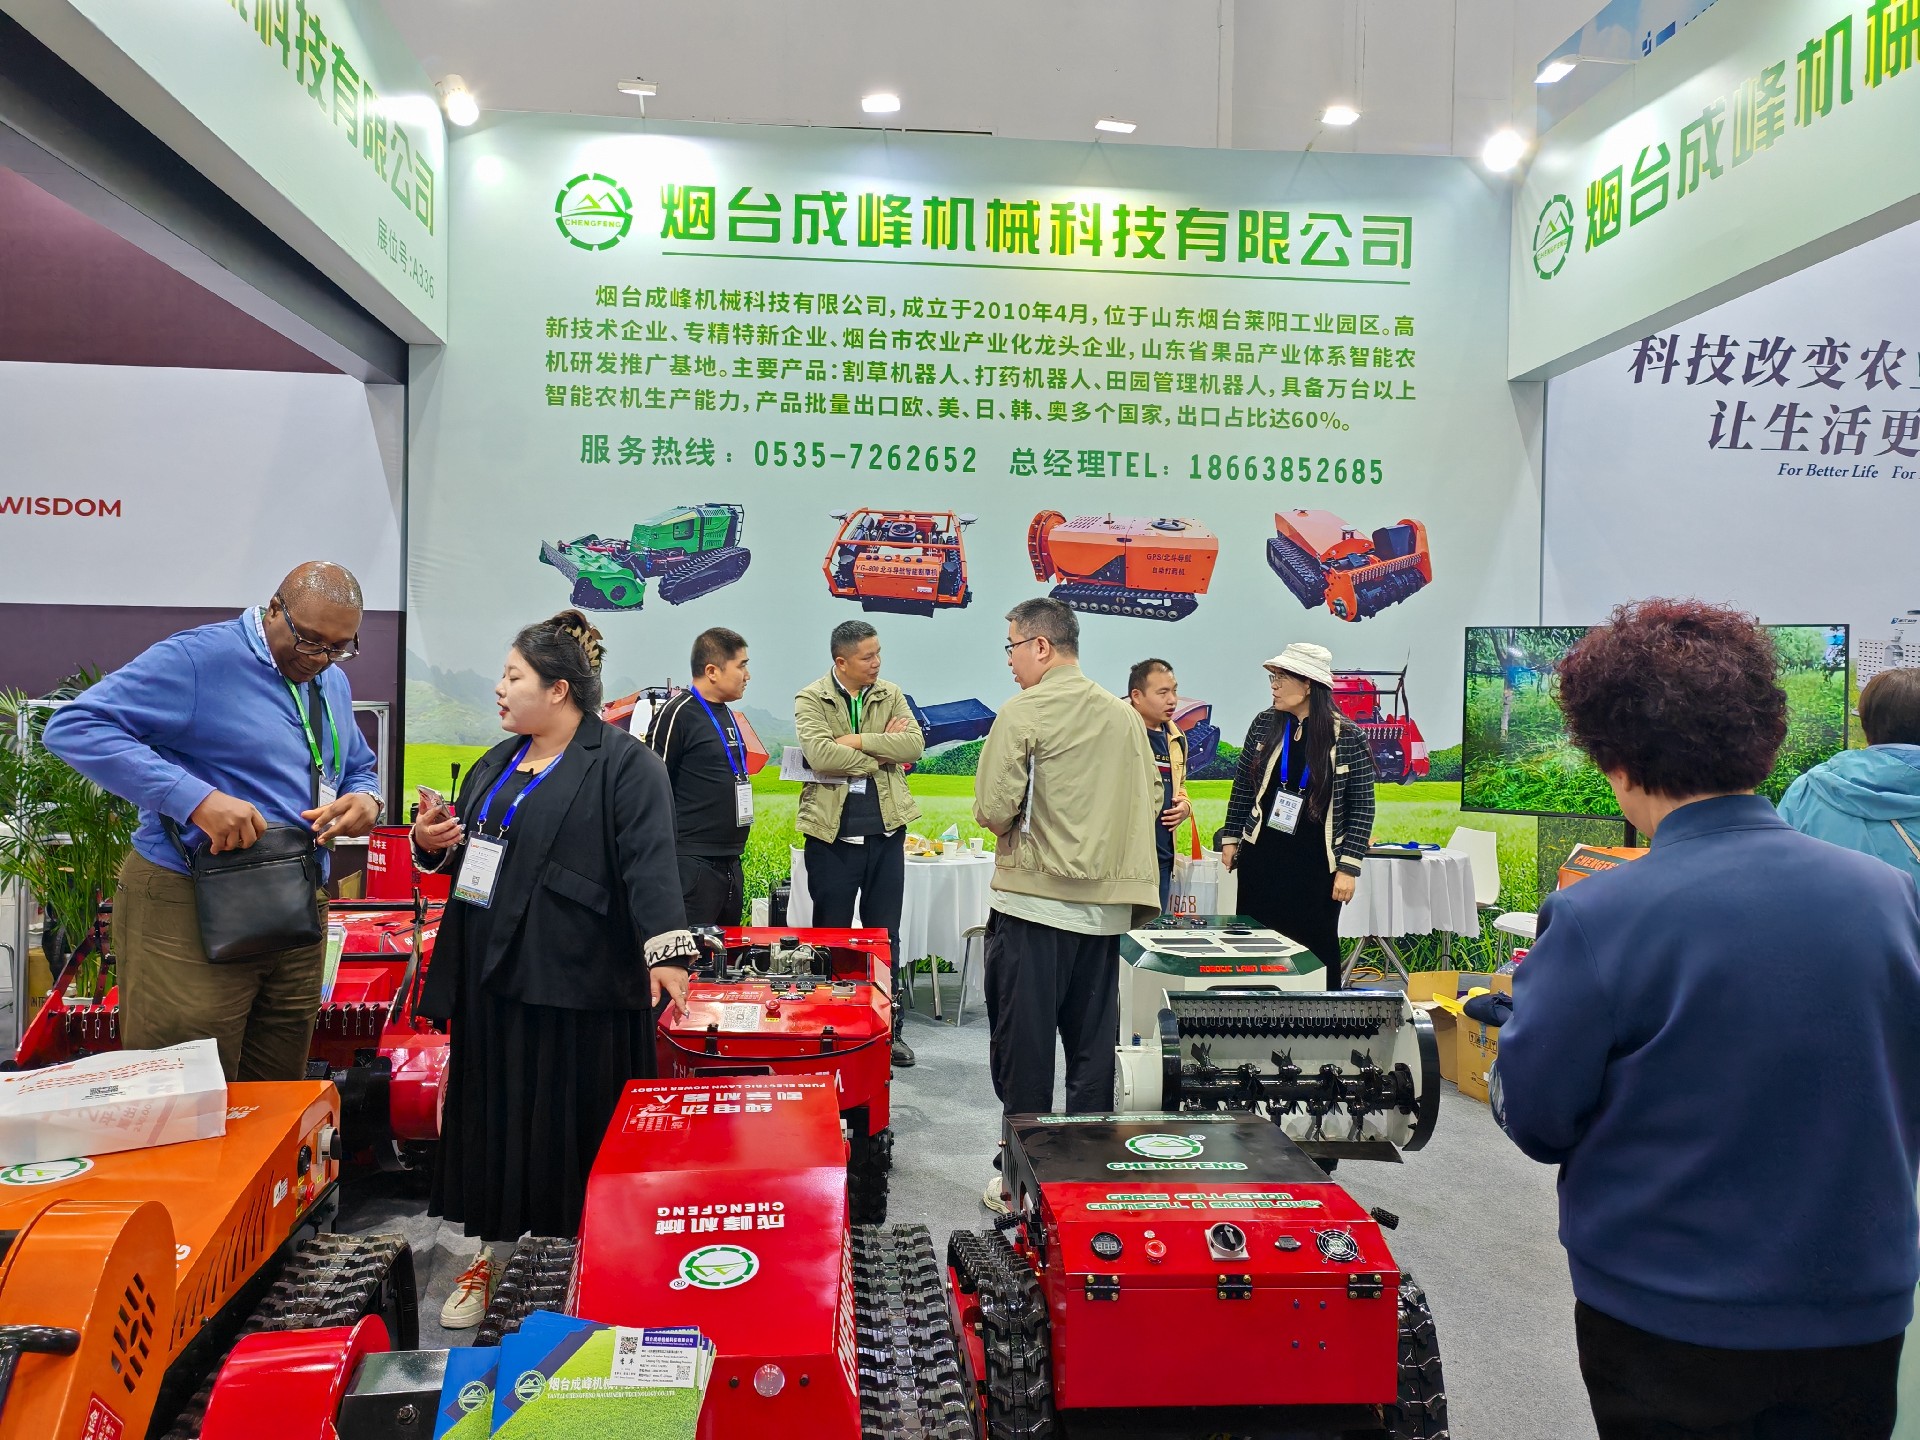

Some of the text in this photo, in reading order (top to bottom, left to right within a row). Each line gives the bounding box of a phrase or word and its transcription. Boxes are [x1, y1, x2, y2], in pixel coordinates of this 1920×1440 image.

[564, 217, 622, 229] CHENGFENG
[660, 184, 1414, 270] 烟台成峰机械科技有限公司
[1628, 333, 1920, 391] 科技改变农
[754, 440, 977, 473] 0535-7262652
[1188, 453, 1384, 485] 18663852685
[1778, 462, 1917, 480] For Better Life For
[0, 496, 122, 518] WISDOM
[680, 1102, 773, 1116] 纯电动
[1108, 1162, 1247, 1171] CHENGFENG
[1107, 1192, 1293, 1201] GRASS COLLECTION
[657, 1201, 785, 1216] CHENGFENG
[655, 1213, 786, 1235] 成峰机械
